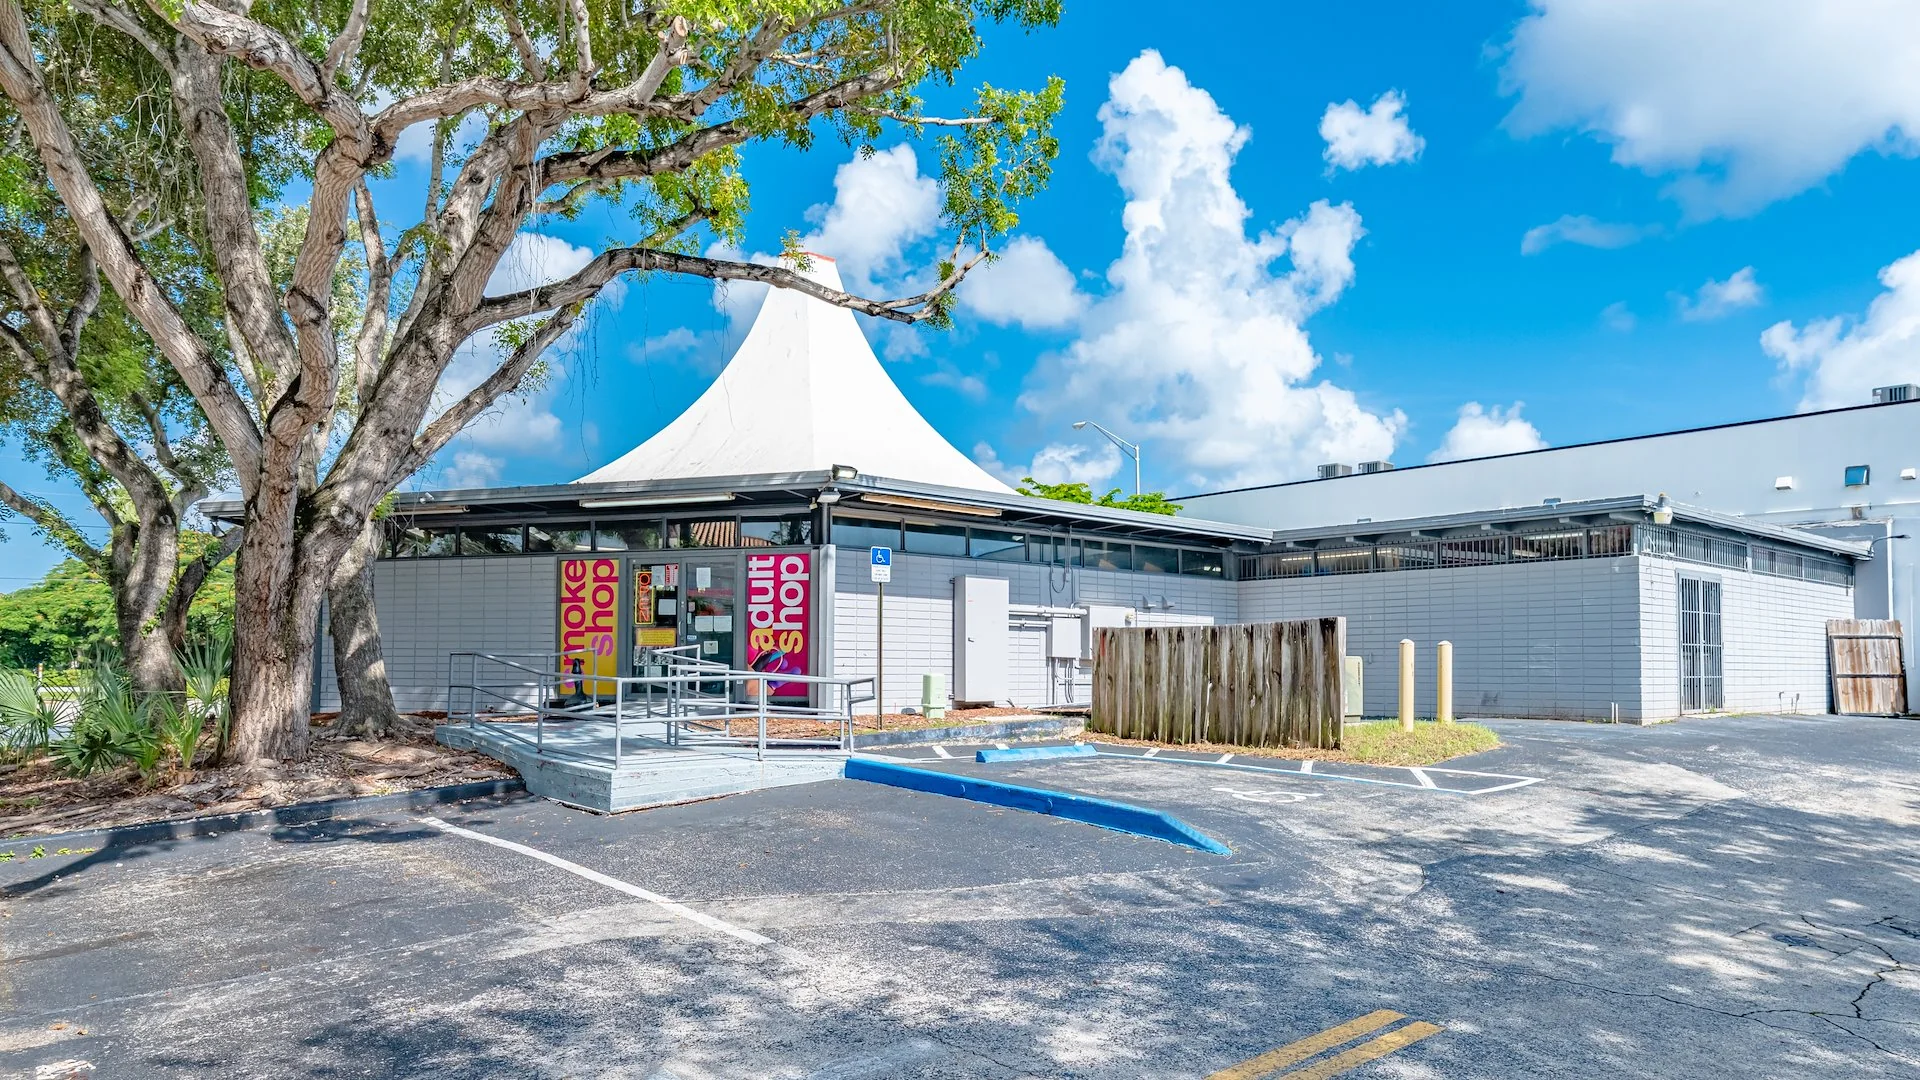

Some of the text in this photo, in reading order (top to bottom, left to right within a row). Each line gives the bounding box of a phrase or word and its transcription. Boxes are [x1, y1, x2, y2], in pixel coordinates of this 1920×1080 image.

[585, 558, 619, 656] shop
[639, 573, 650, 622] OPEN
[748, 556, 775, 651] adult
[773, 556, 810, 653] shop
